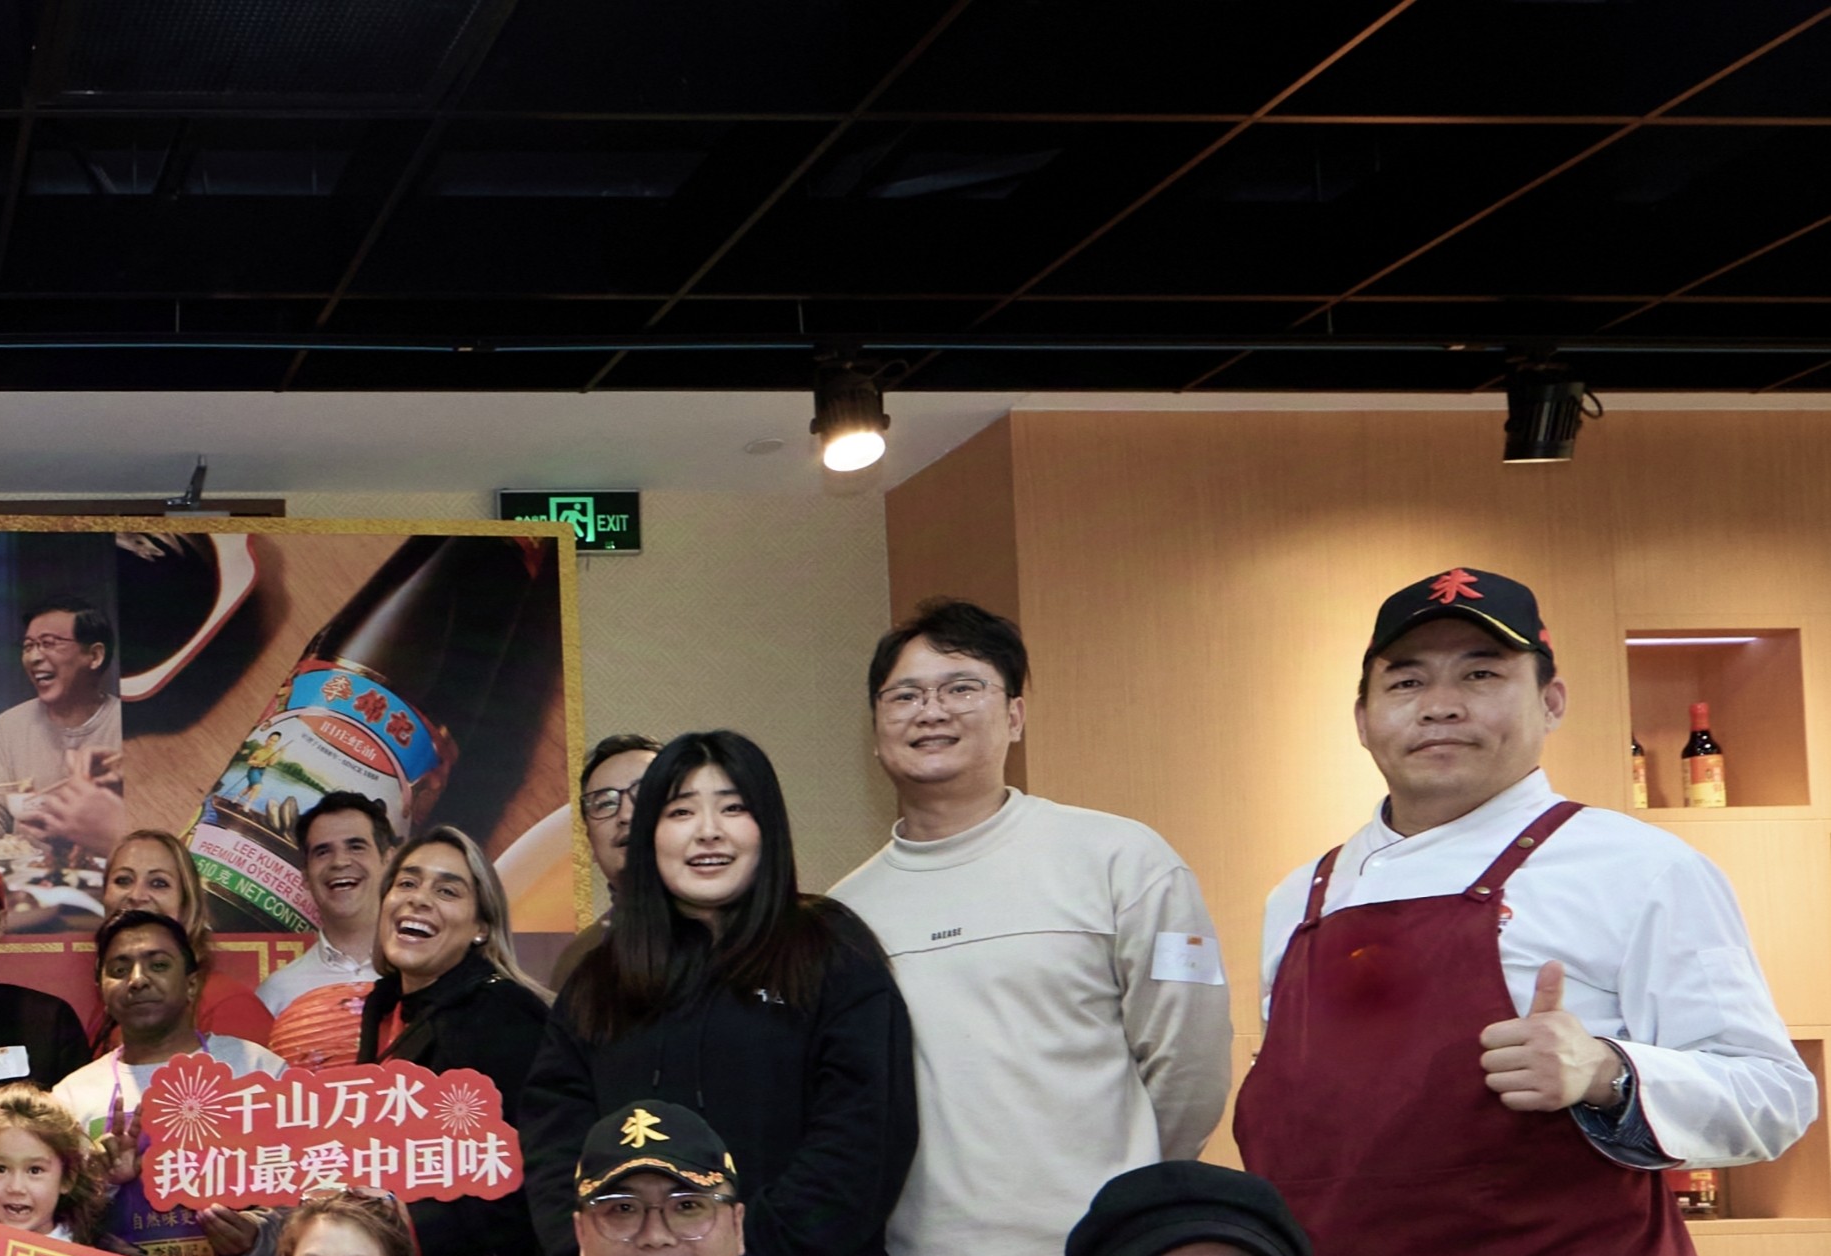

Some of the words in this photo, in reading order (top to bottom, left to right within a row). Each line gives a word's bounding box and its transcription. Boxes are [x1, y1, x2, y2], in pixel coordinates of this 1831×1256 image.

[597, 515, 629, 531] EXIT
[197, 859, 217, 877] 510
[235, 878, 266, 899] NET
[198, 841, 247, 870] PREMIUM
[247, 863, 294, 898] OYSTER
[233, 841, 257, 859] LEE
[257, 853, 284, 874] KUM
[226, 1074, 429, 1134] 千山万水
[153, 1132, 512, 1200] 我们最爱中国味
